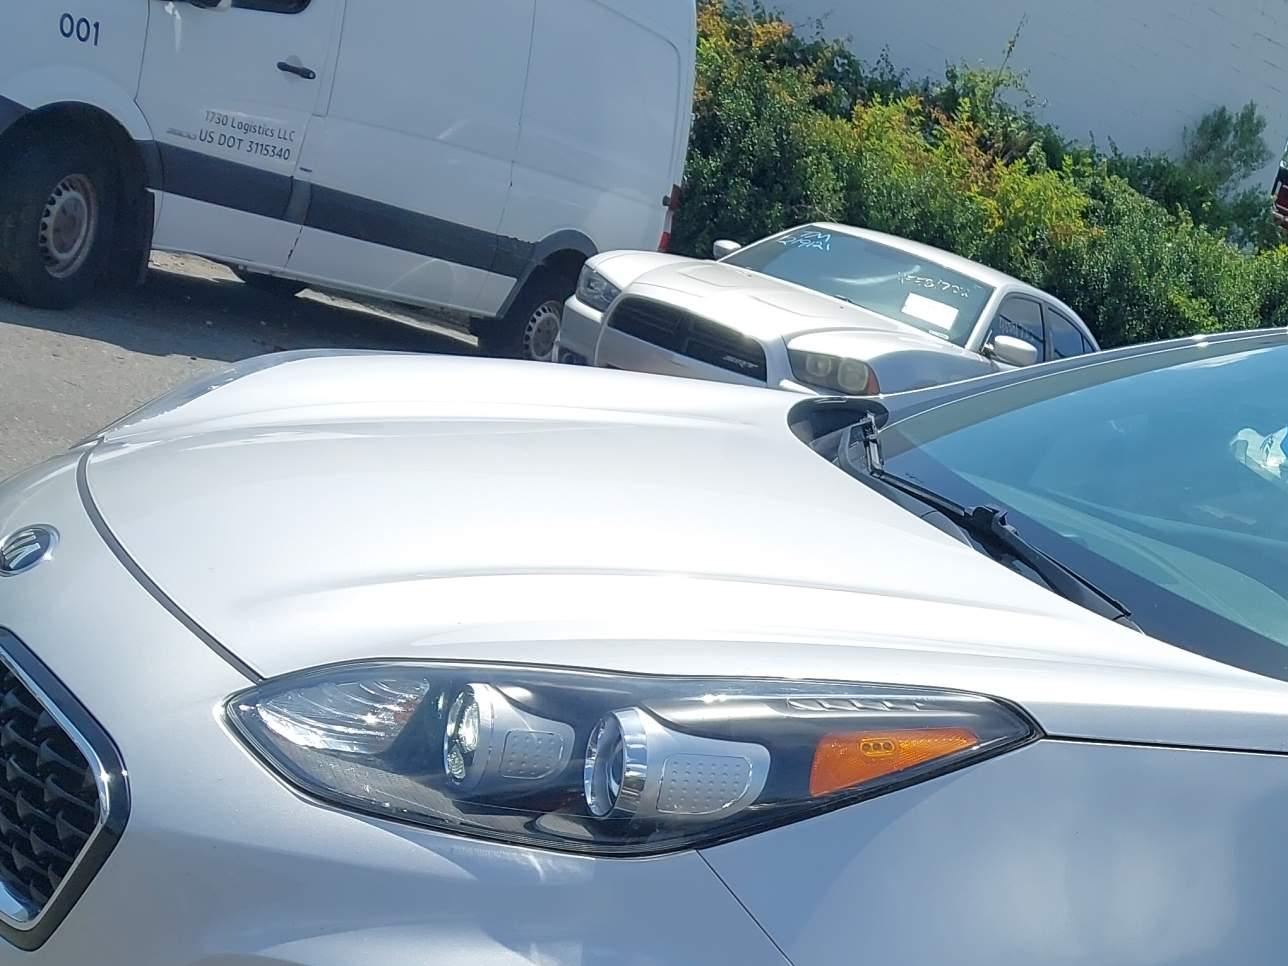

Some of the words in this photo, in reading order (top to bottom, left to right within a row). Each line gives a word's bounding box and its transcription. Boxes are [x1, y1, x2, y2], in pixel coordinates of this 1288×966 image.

[60, 13, 99, 46] 001
[205, 110, 229, 126] 1730
[231, 118, 274, 138] Logistics
[277, 128, 296, 142] LLC
[199, 128, 215, 143] US
[218, 133, 244, 150] DOT
[246, 140, 291, 160] 3115340
